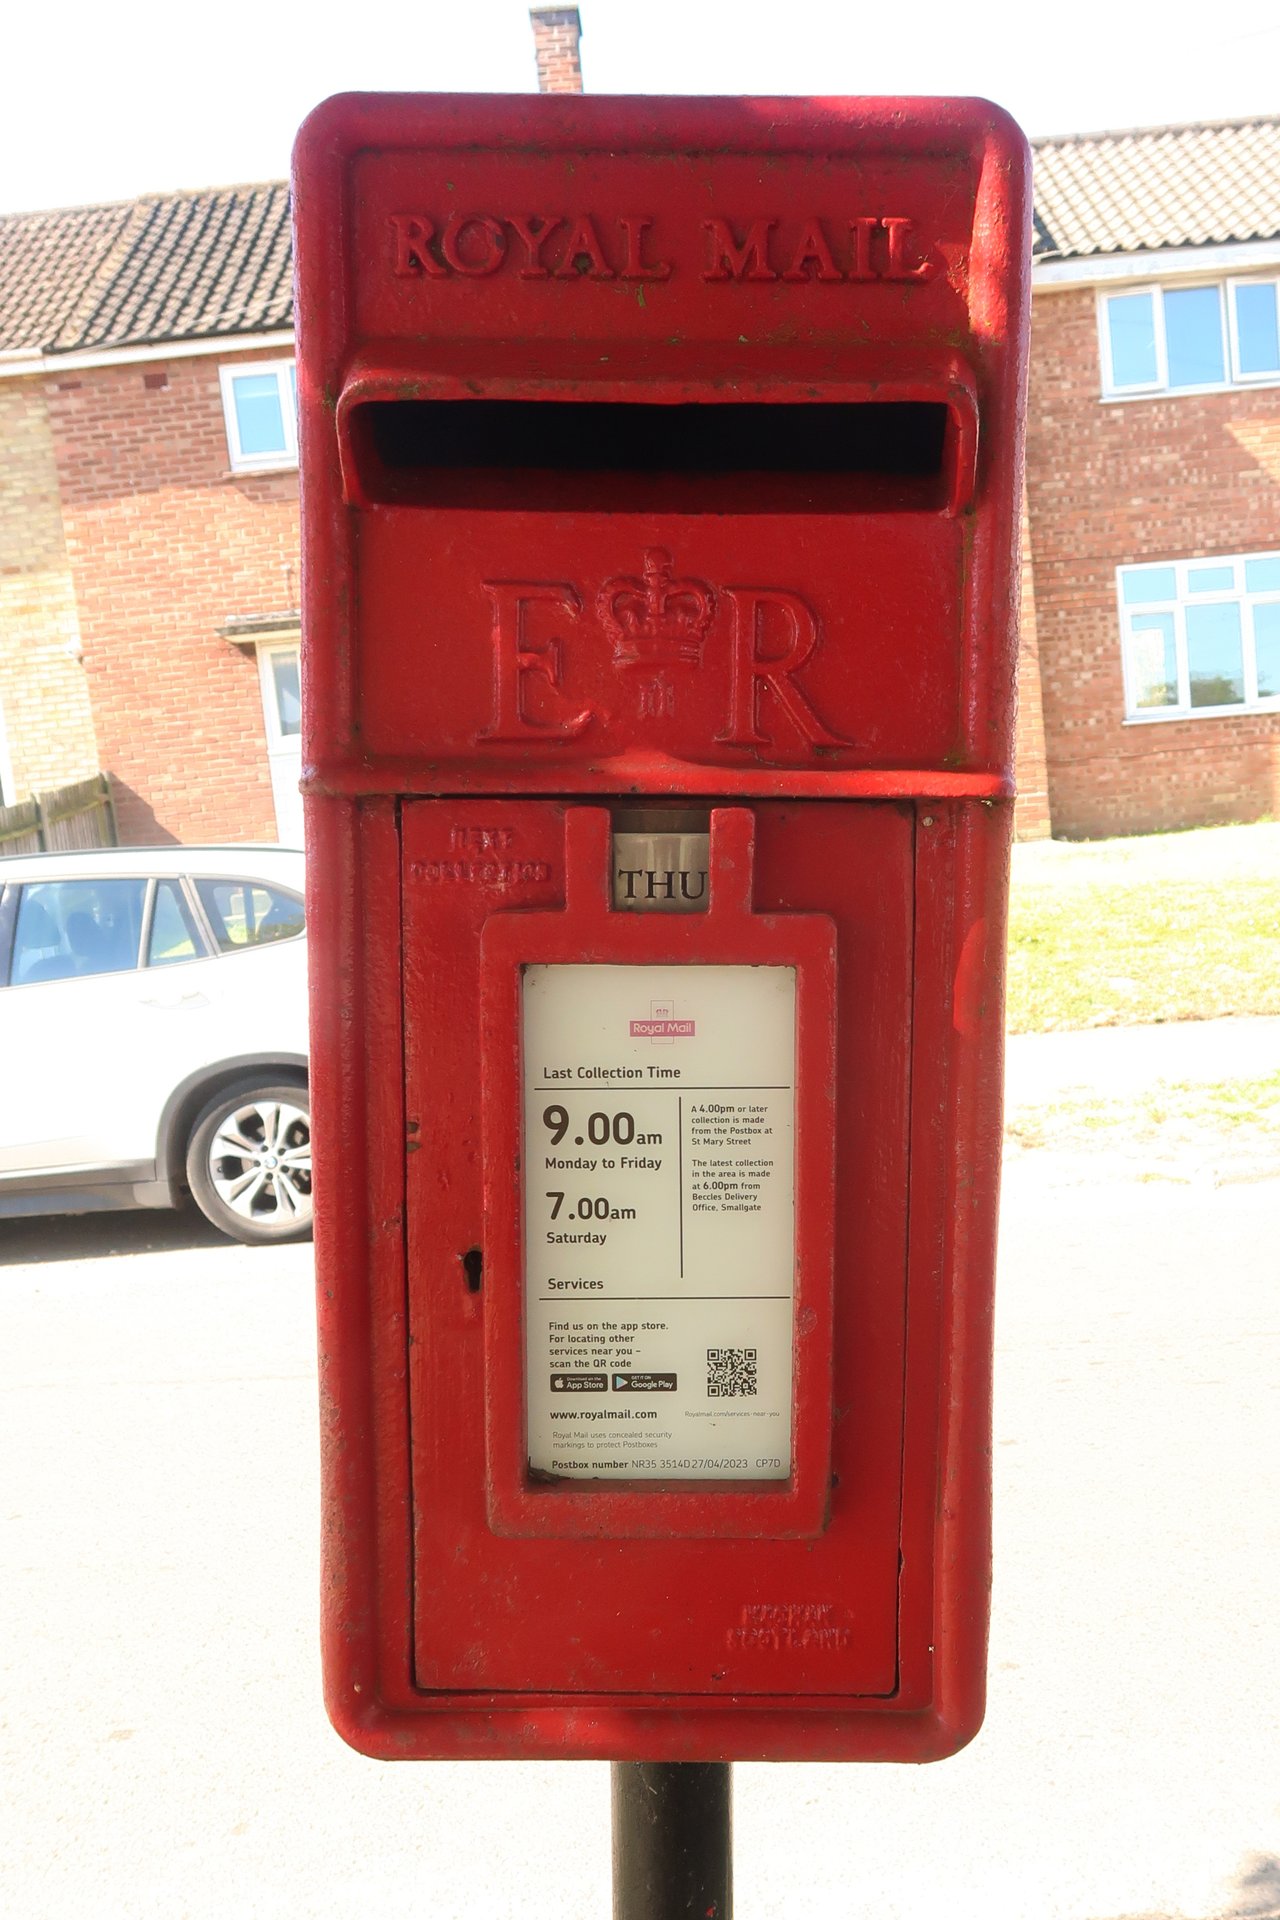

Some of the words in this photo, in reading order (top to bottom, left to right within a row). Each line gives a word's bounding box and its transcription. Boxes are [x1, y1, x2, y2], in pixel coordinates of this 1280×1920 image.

[389, 214, 672, 280] ROYAL
[703, 216, 934, 282] MAIL
[475, 579, 596, 746] E
[712, 584, 859, 749] R
[618, 869, 709, 900] THU
[632, 1022, 666, 1035] Royal
[667, 1022, 692, 1034] Mail
[543, 1066, 573, 1080] Last
[577, 1066, 643, 1079] Collection
[647, 1066, 681, 1079] Time
[691, 1105, 698, 1113] A
[699, 1104, 735, 1114] 4.00pm
[748, 1105, 768, 1113] later
[691, 1116, 730, 1124] collection
[733, 1116, 740, 1124] is
[742, 1116, 765, 1124] made
[543, 1105, 662, 1146] 9.00am
[691, 1127, 711, 1135] from
[714, 1127, 728, 1135] the
[730, 1127, 762, 1135] Postbox
[764, 1127, 773, 1135] at
[703, 1138, 724, 1146] Mary
[545, 1157, 597, 1171] Monday
[602, 1157, 616, 1170] to
[620, 1157, 662, 1171] Friday
[692, 1159, 708, 1167] The
[709, 1159, 733, 1167] latest
[735, 1159, 774, 1167] collection
[692, 1170, 700, 1178] in
[702, 1170, 716, 1178] the
[738, 1170, 746, 1178] is
[748, 1170, 771, 1178] made
[692, 1182, 701, 1190] at
[703, 1181, 739, 1191] 6.00pm
[741, 1182, 761, 1190] from
[692, 1193, 722, 1201] Beccles
[724, 1193, 758, 1202] Delivery
[546, 1192, 636, 1220] 7.00am
[692, 1203, 719, 1212] Office,
[721, 1203, 762, 1213] Smallgate
[546, 1232, 607, 1246] Saturday
[548, 1278, 604, 1290] Services
[549, 1322, 570, 1330] Find
[602, 1322, 618, 1330] the
[620, 1323, 639, 1332] app
[641, 1322, 669, 1330] store.
[549, 1335, 565, 1343] For
[567, 1334, 606, 1344] locating
[608, 1334, 635, 1343] other
[549, 1347, 588, 1355] services
[591, 1347, 613, 1355] near
[615, 1347, 633, 1357] you
[549, 1360, 572, 1368] scan
[574, 1359, 590, 1368] the
[593, 1359, 607, 1368] QR
[609, 1359, 632, 1368] code
[566, 1382, 582, 1390] App
[583, 1381, 604, 1389] Store
[631, 1380, 657, 1390] Google
[658, 1380, 673, 1389] Play
[550, 1409, 658, 1421] www.royalmail.com
[552, 1432, 572, 1440] Royal
[608, 1431, 643, 1439] concealed
[644, 1431, 673, 1439] security
[552, 1441, 585, 1449] markings
[596, 1441, 620, 1449] protect
[551, 1460, 589, 1469] Postbox
[592, 1460, 629, 1469] number
[631, 1460, 657, 1469] NR35
[660, 1460, 690, 1469] 3514D
[691, 1459, 748, 1469] 27/04/2023
[755, 1459, 781, 1468] CP7D
